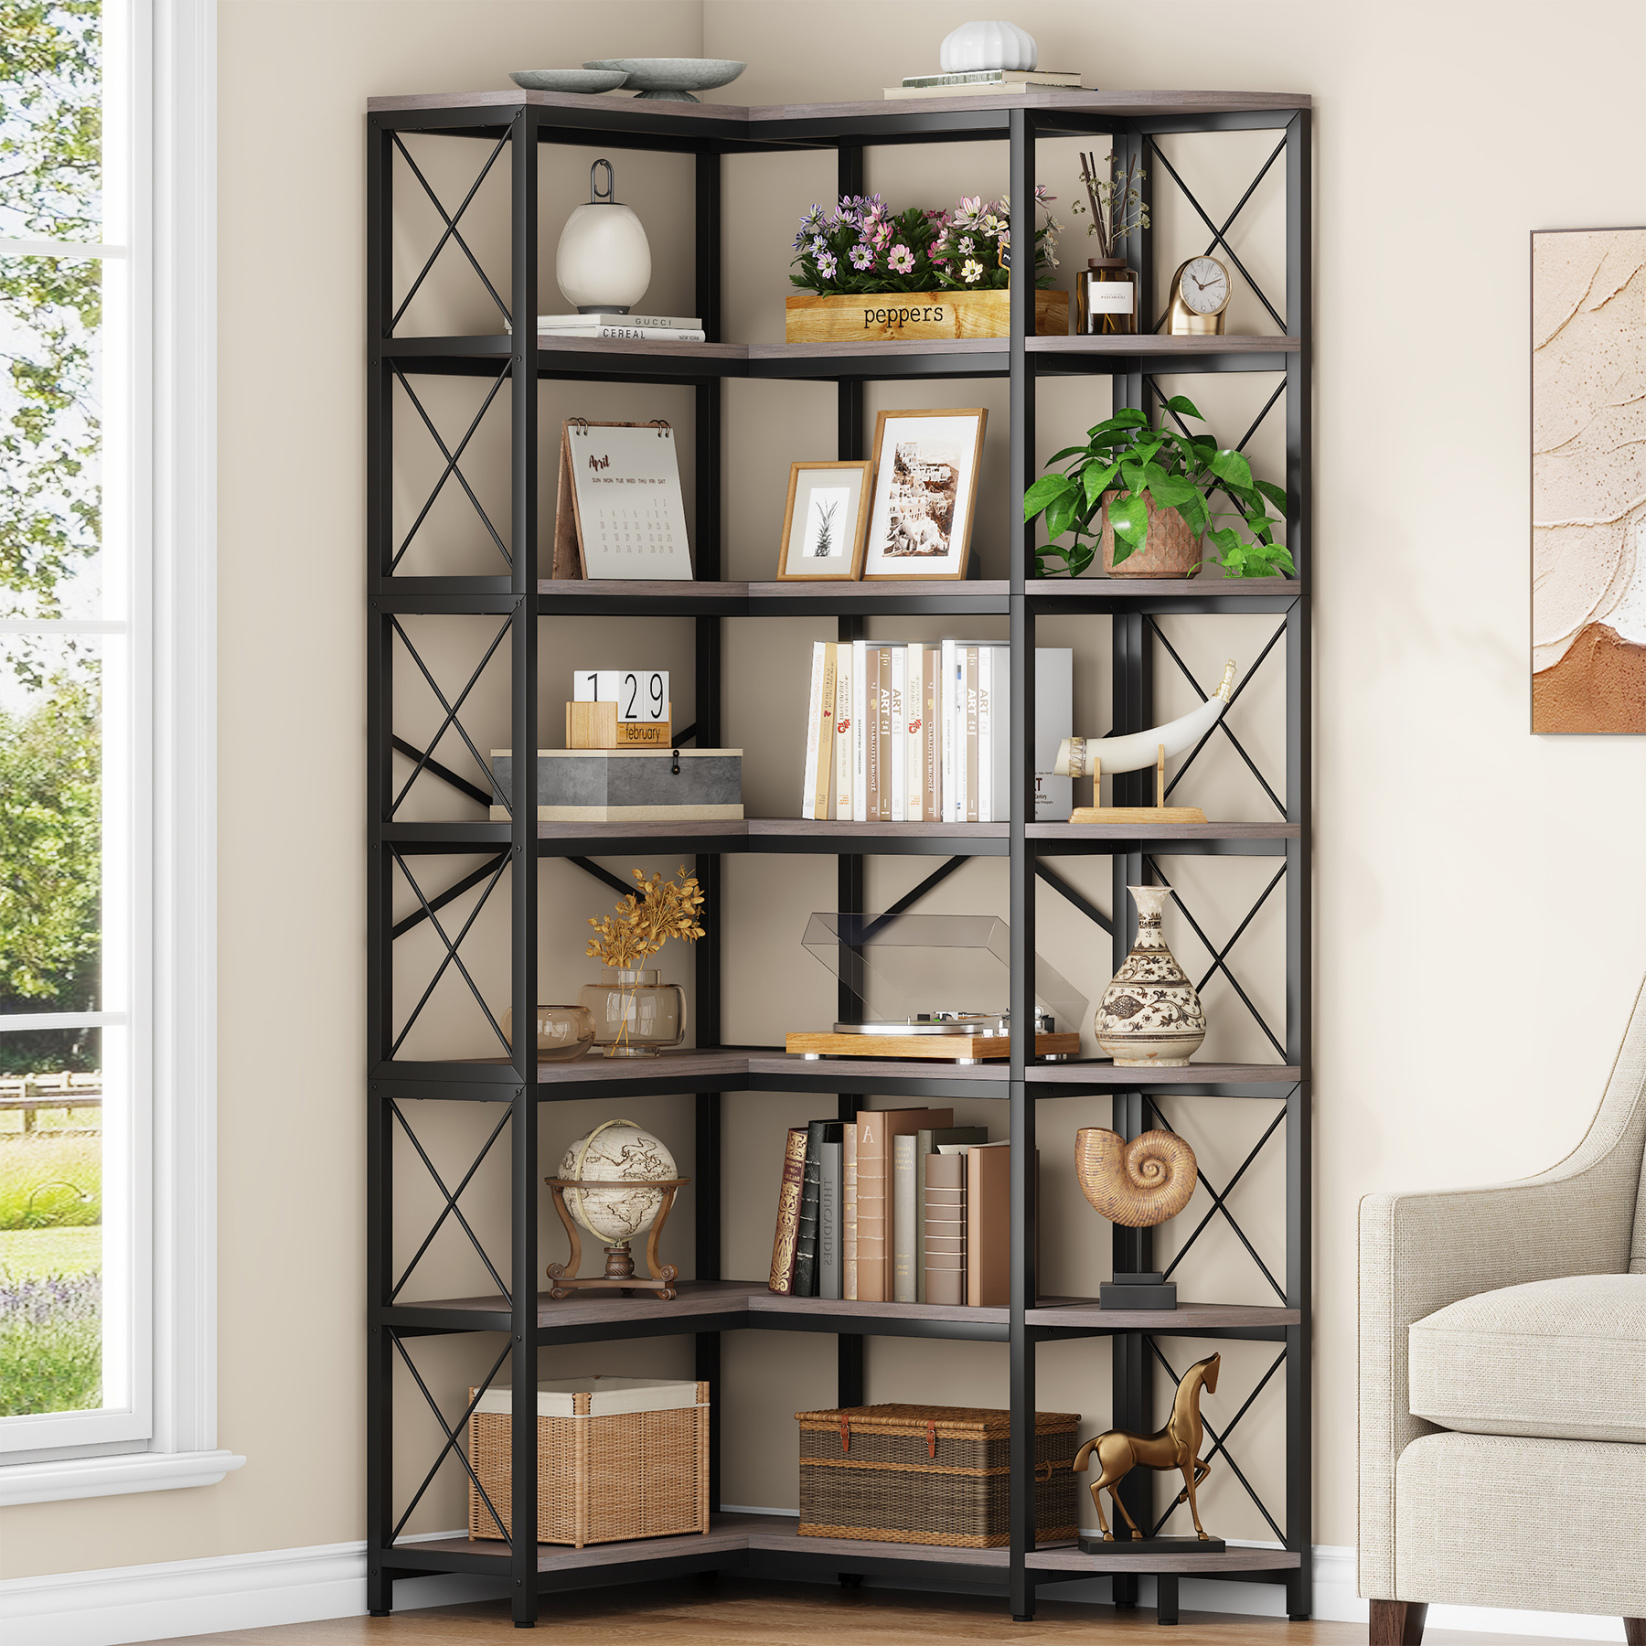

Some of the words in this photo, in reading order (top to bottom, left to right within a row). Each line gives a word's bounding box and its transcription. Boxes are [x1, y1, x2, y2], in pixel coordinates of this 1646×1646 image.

[635, 317, 672, 327] GUCCI
[863, 305, 944, 329] peppers
[602, 328, 646, 339] CEREAL
[589, 454, 610, 472] April
[881, 688, 890, 716] ART
[893, 688, 902, 716] ART
[967, 688, 977, 716] ART
[980, 688, 989, 716] ART
[625, 723, 661, 743] february
[861, 1125, 875, 1144] A
